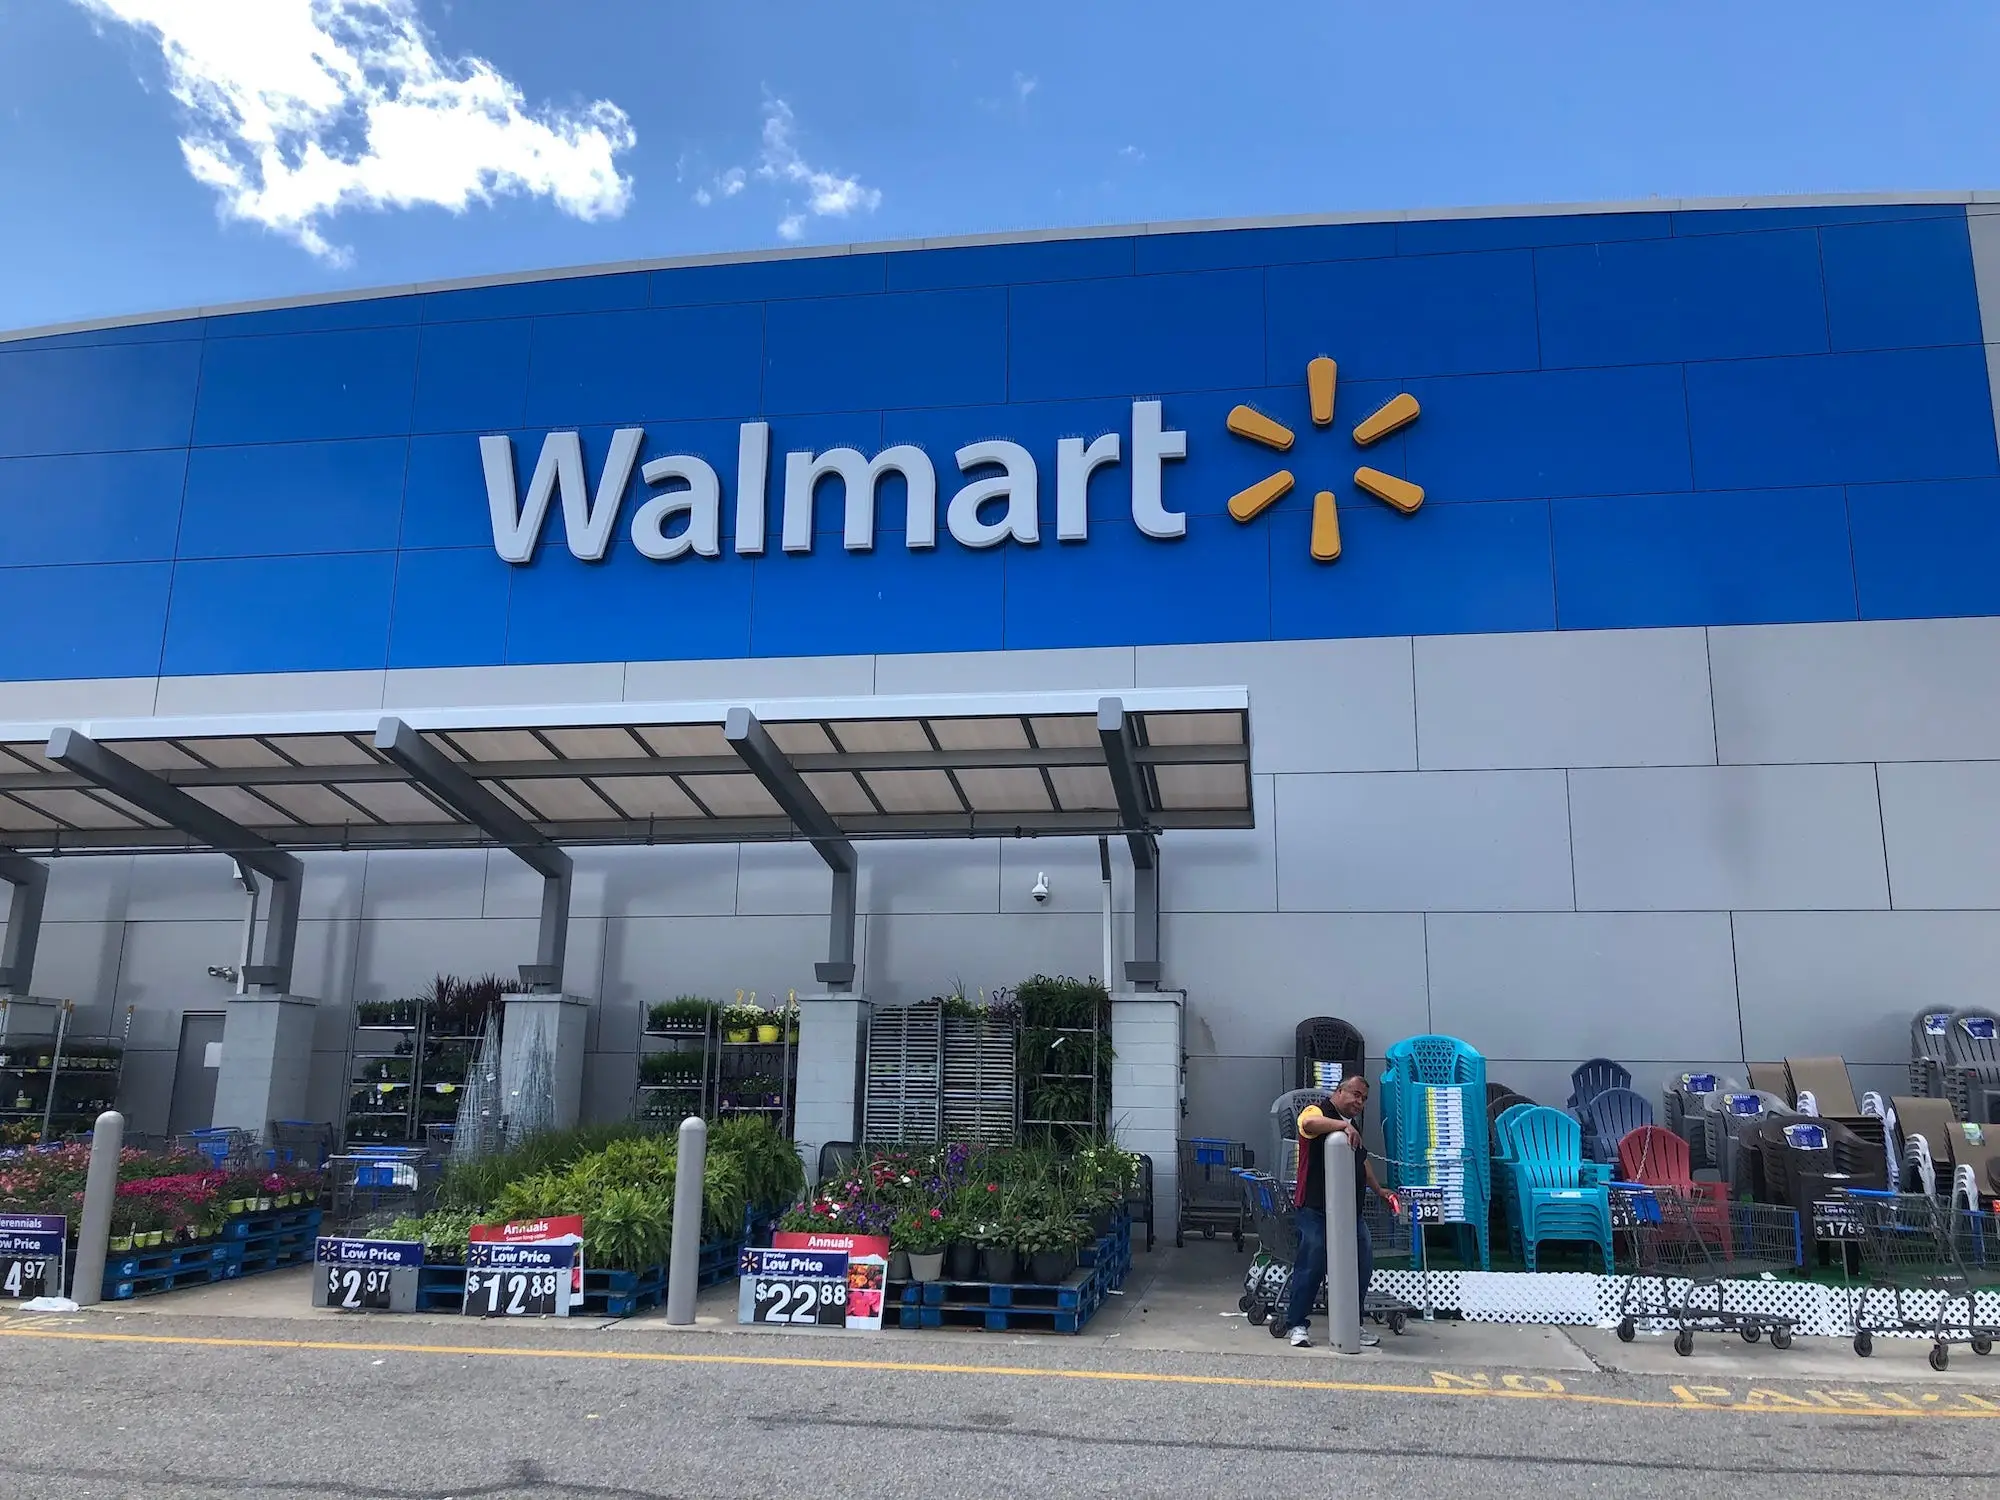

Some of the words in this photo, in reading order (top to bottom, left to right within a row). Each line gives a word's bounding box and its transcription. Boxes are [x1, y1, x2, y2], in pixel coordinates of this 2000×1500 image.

[477, 400, 1188, 564] Walmart
[0, 1218, 42, 1228] erennials
[503, 1221, 549, 1235] Annuals
[14, 1238, 41, 1250] Price
[807, 1236, 854, 1249] Annuals
[340, 1247, 367, 1259] Low
[369, 1248, 401, 1261] Price
[491, 1250, 518, 1263] Low
[520, 1250, 551, 1263] Price
[762, 1258, 789, 1271] Low
[791, 1259, 823, 1272] Price
[1429, 1371, 1566, 1392] NO
